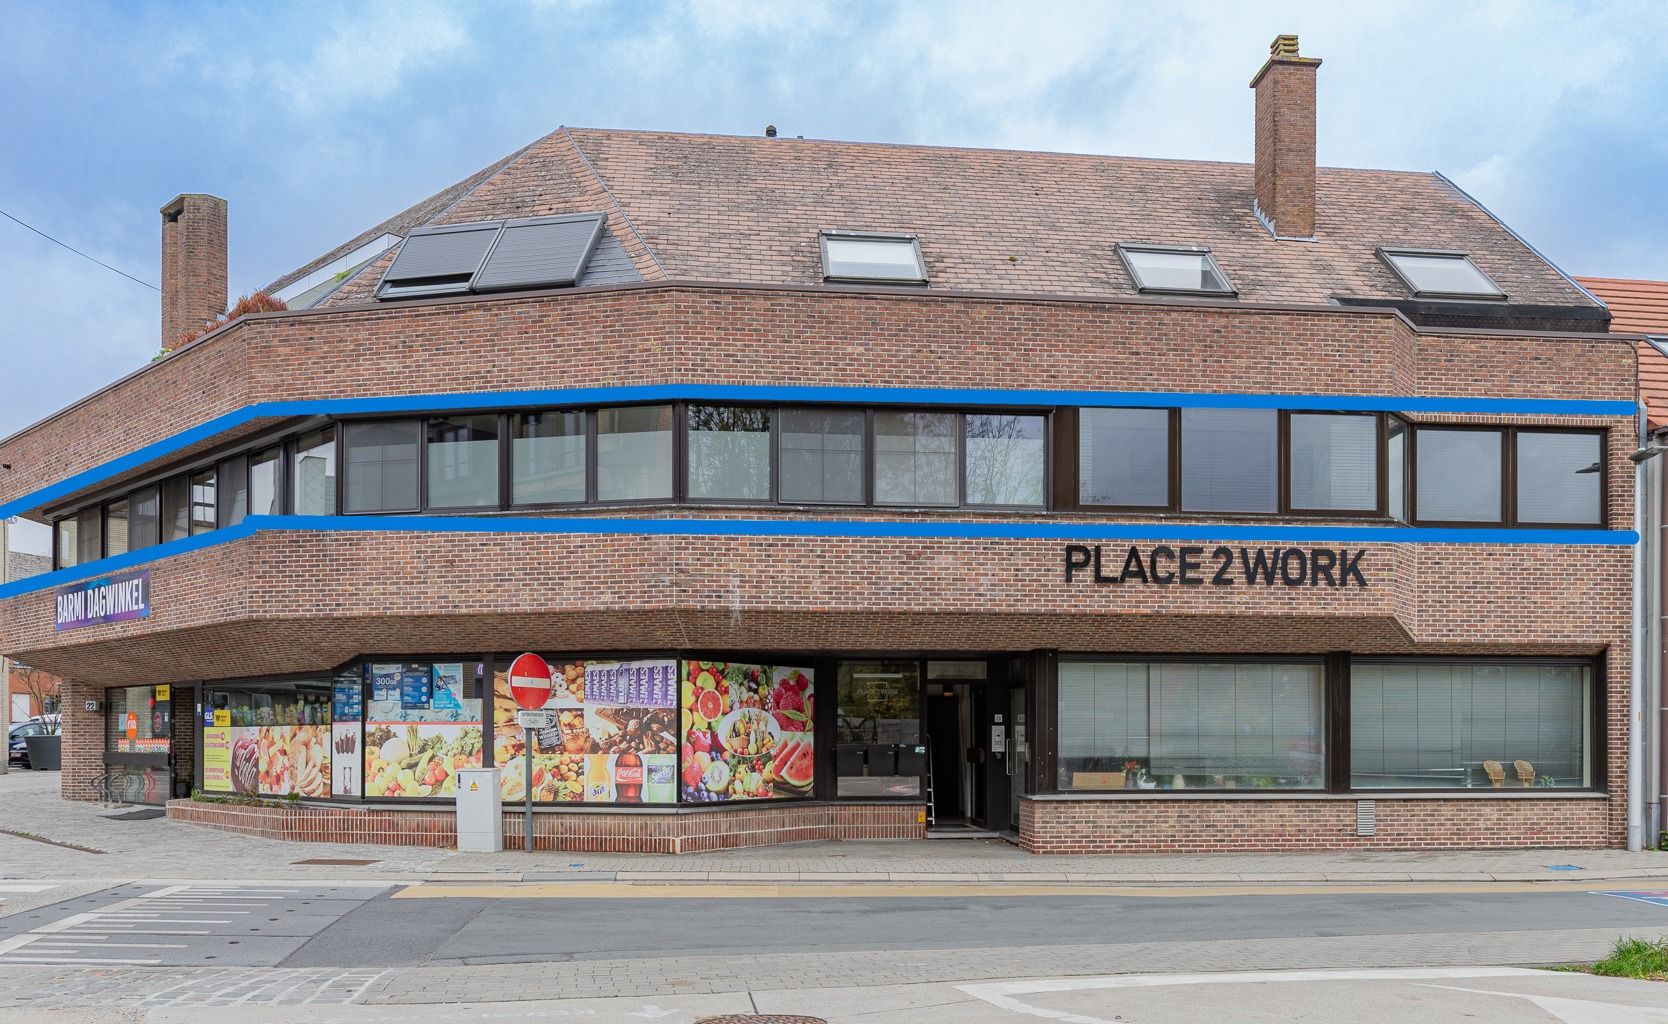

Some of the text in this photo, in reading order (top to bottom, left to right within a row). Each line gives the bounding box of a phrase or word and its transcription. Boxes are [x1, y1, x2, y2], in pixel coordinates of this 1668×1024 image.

[57, 578, 145, 624] BARMI DAGWINKEL
[86, 702, 95, 710] 22
[616, 766, 642, 779] Coca-Cola
